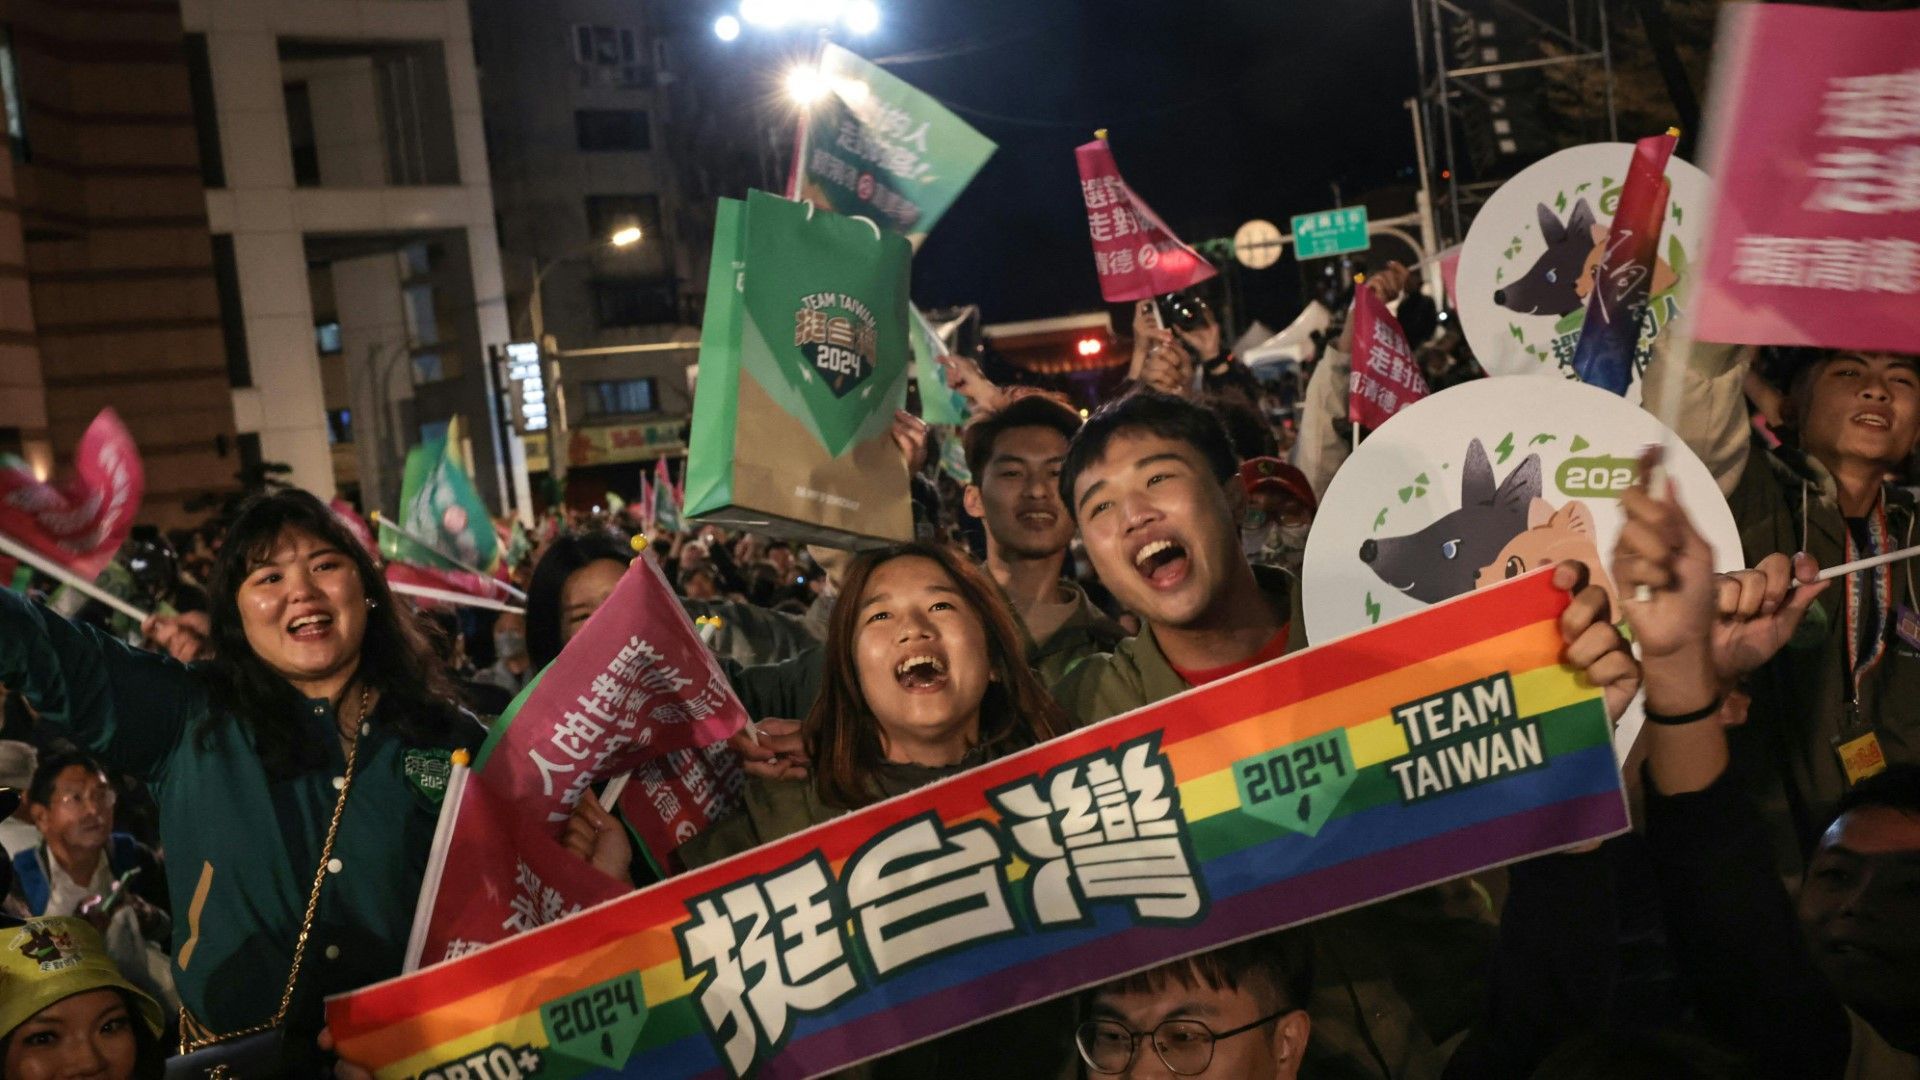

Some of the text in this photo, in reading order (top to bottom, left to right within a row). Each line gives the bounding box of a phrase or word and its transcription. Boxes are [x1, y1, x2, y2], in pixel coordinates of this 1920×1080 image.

[801, 293, 877, 328] TEAM TAIWAN
[817, 345, 861, 378] 2024
[1565, 467, 1640, 490] 202
[1398, 678, 1512, 747] TEAM
[1243, 739, 1348, 806] 2024
[1391, 723, 1543, 799] TAIWAN
[685, 744, 1201, 1077] 挺台灣
[549, 979, 640, 1044] 2024
